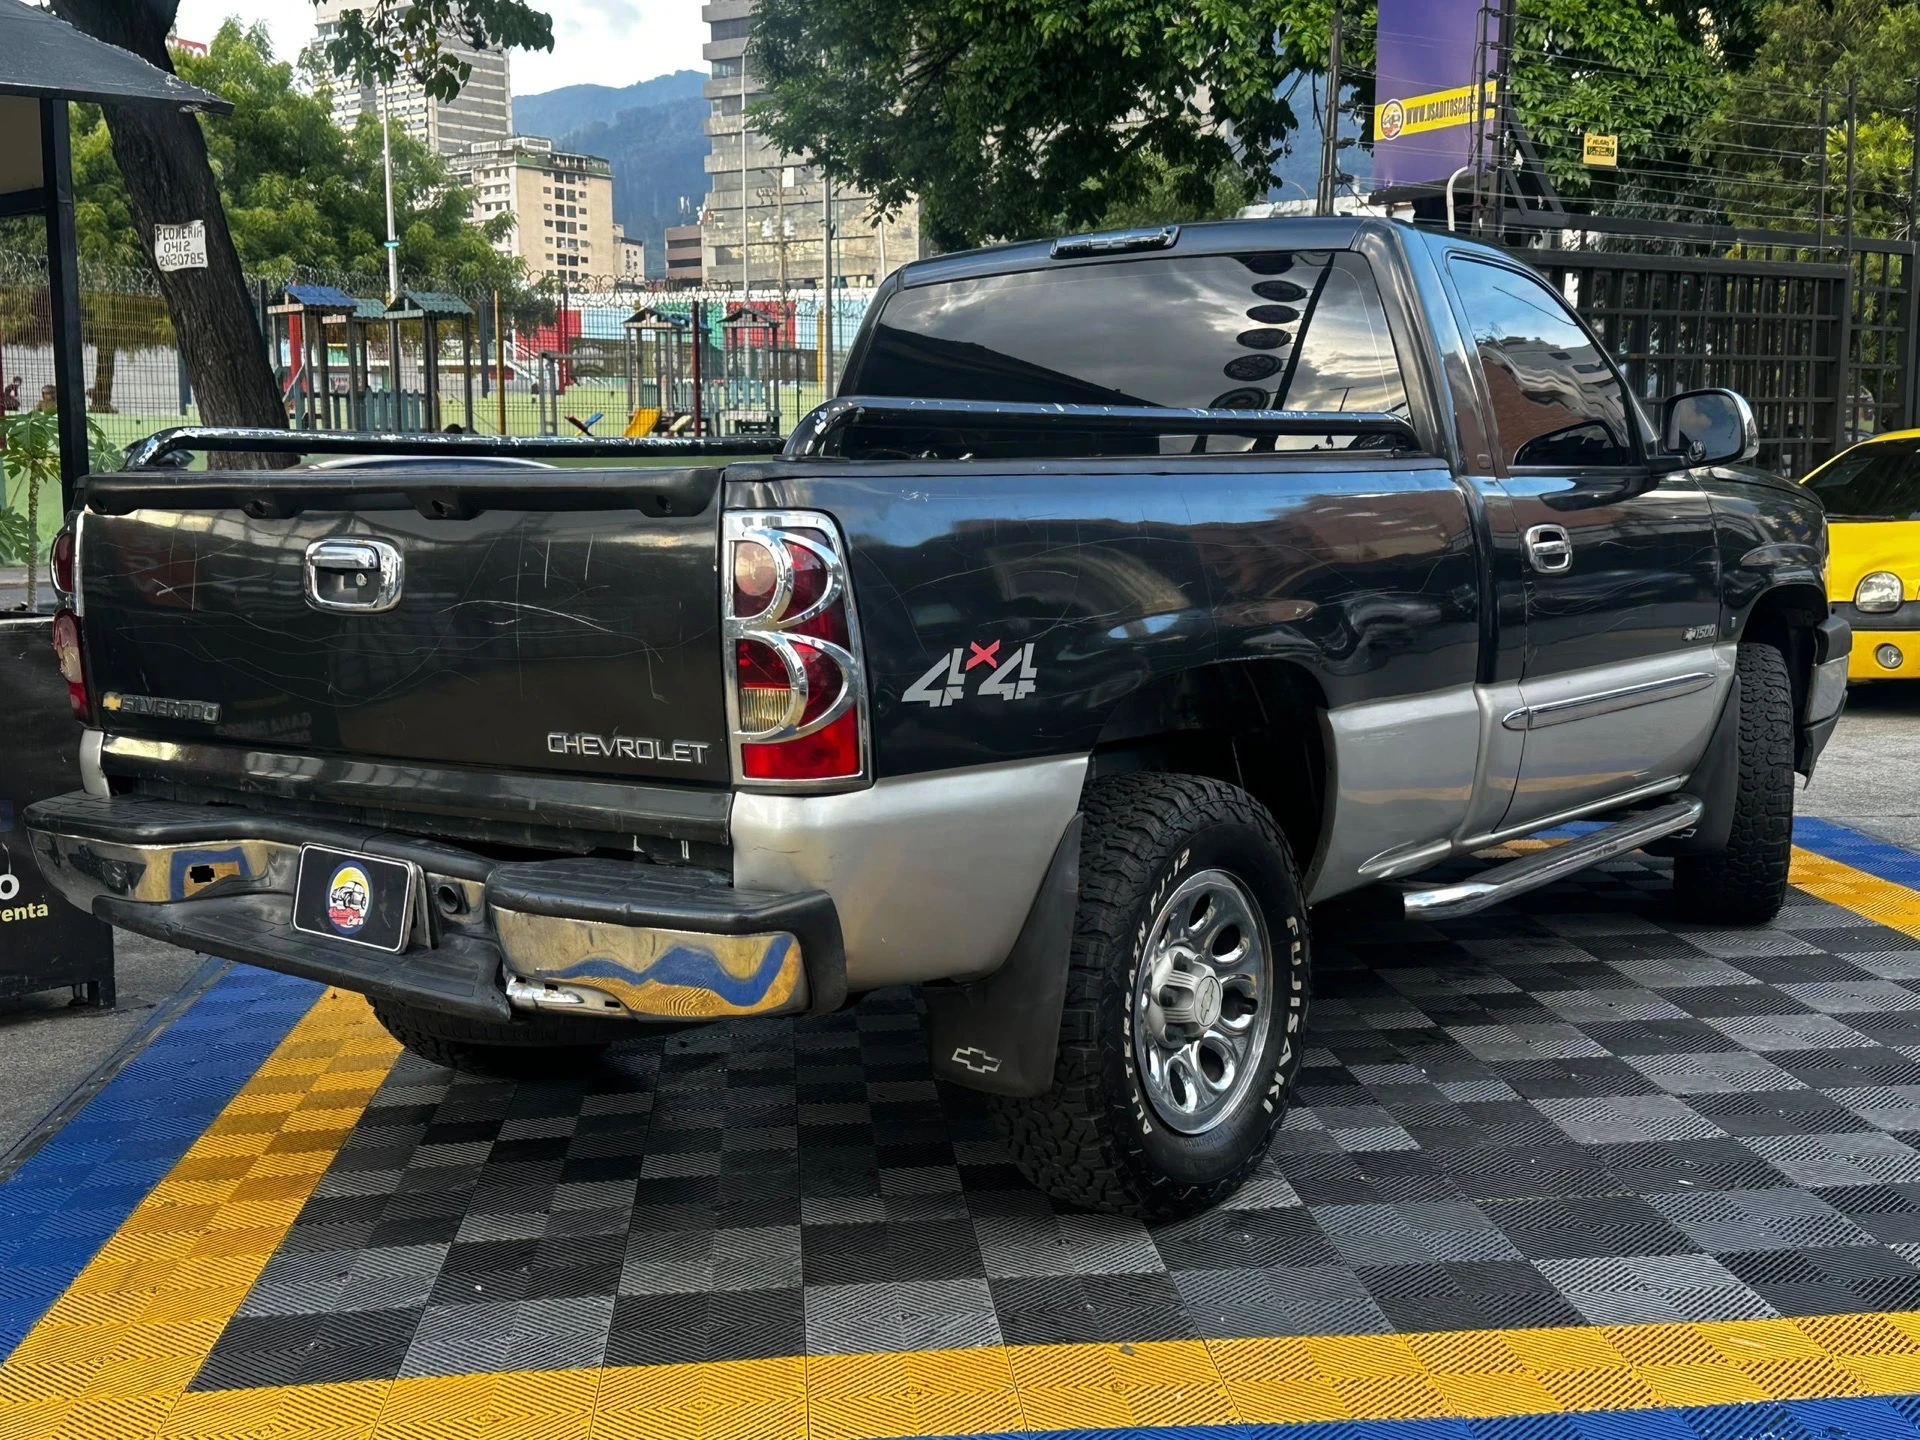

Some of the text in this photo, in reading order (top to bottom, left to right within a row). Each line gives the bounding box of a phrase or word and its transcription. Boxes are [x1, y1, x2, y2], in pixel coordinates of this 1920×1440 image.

[159, 252, 205, 267] 2020785
[163, 241, 191, 254] 0412
[1695, 623, 1716, 640] 1500
[121, 696, 221, 724] SILVERADO
[547, 732, 712, 765] CHEVROLET
[1123, 921, 1147, 1079] TERRAIN
[1263, 915, 1302, 1115] FUJISAKI
[1131, 1088, 1153, 1135] ALL
